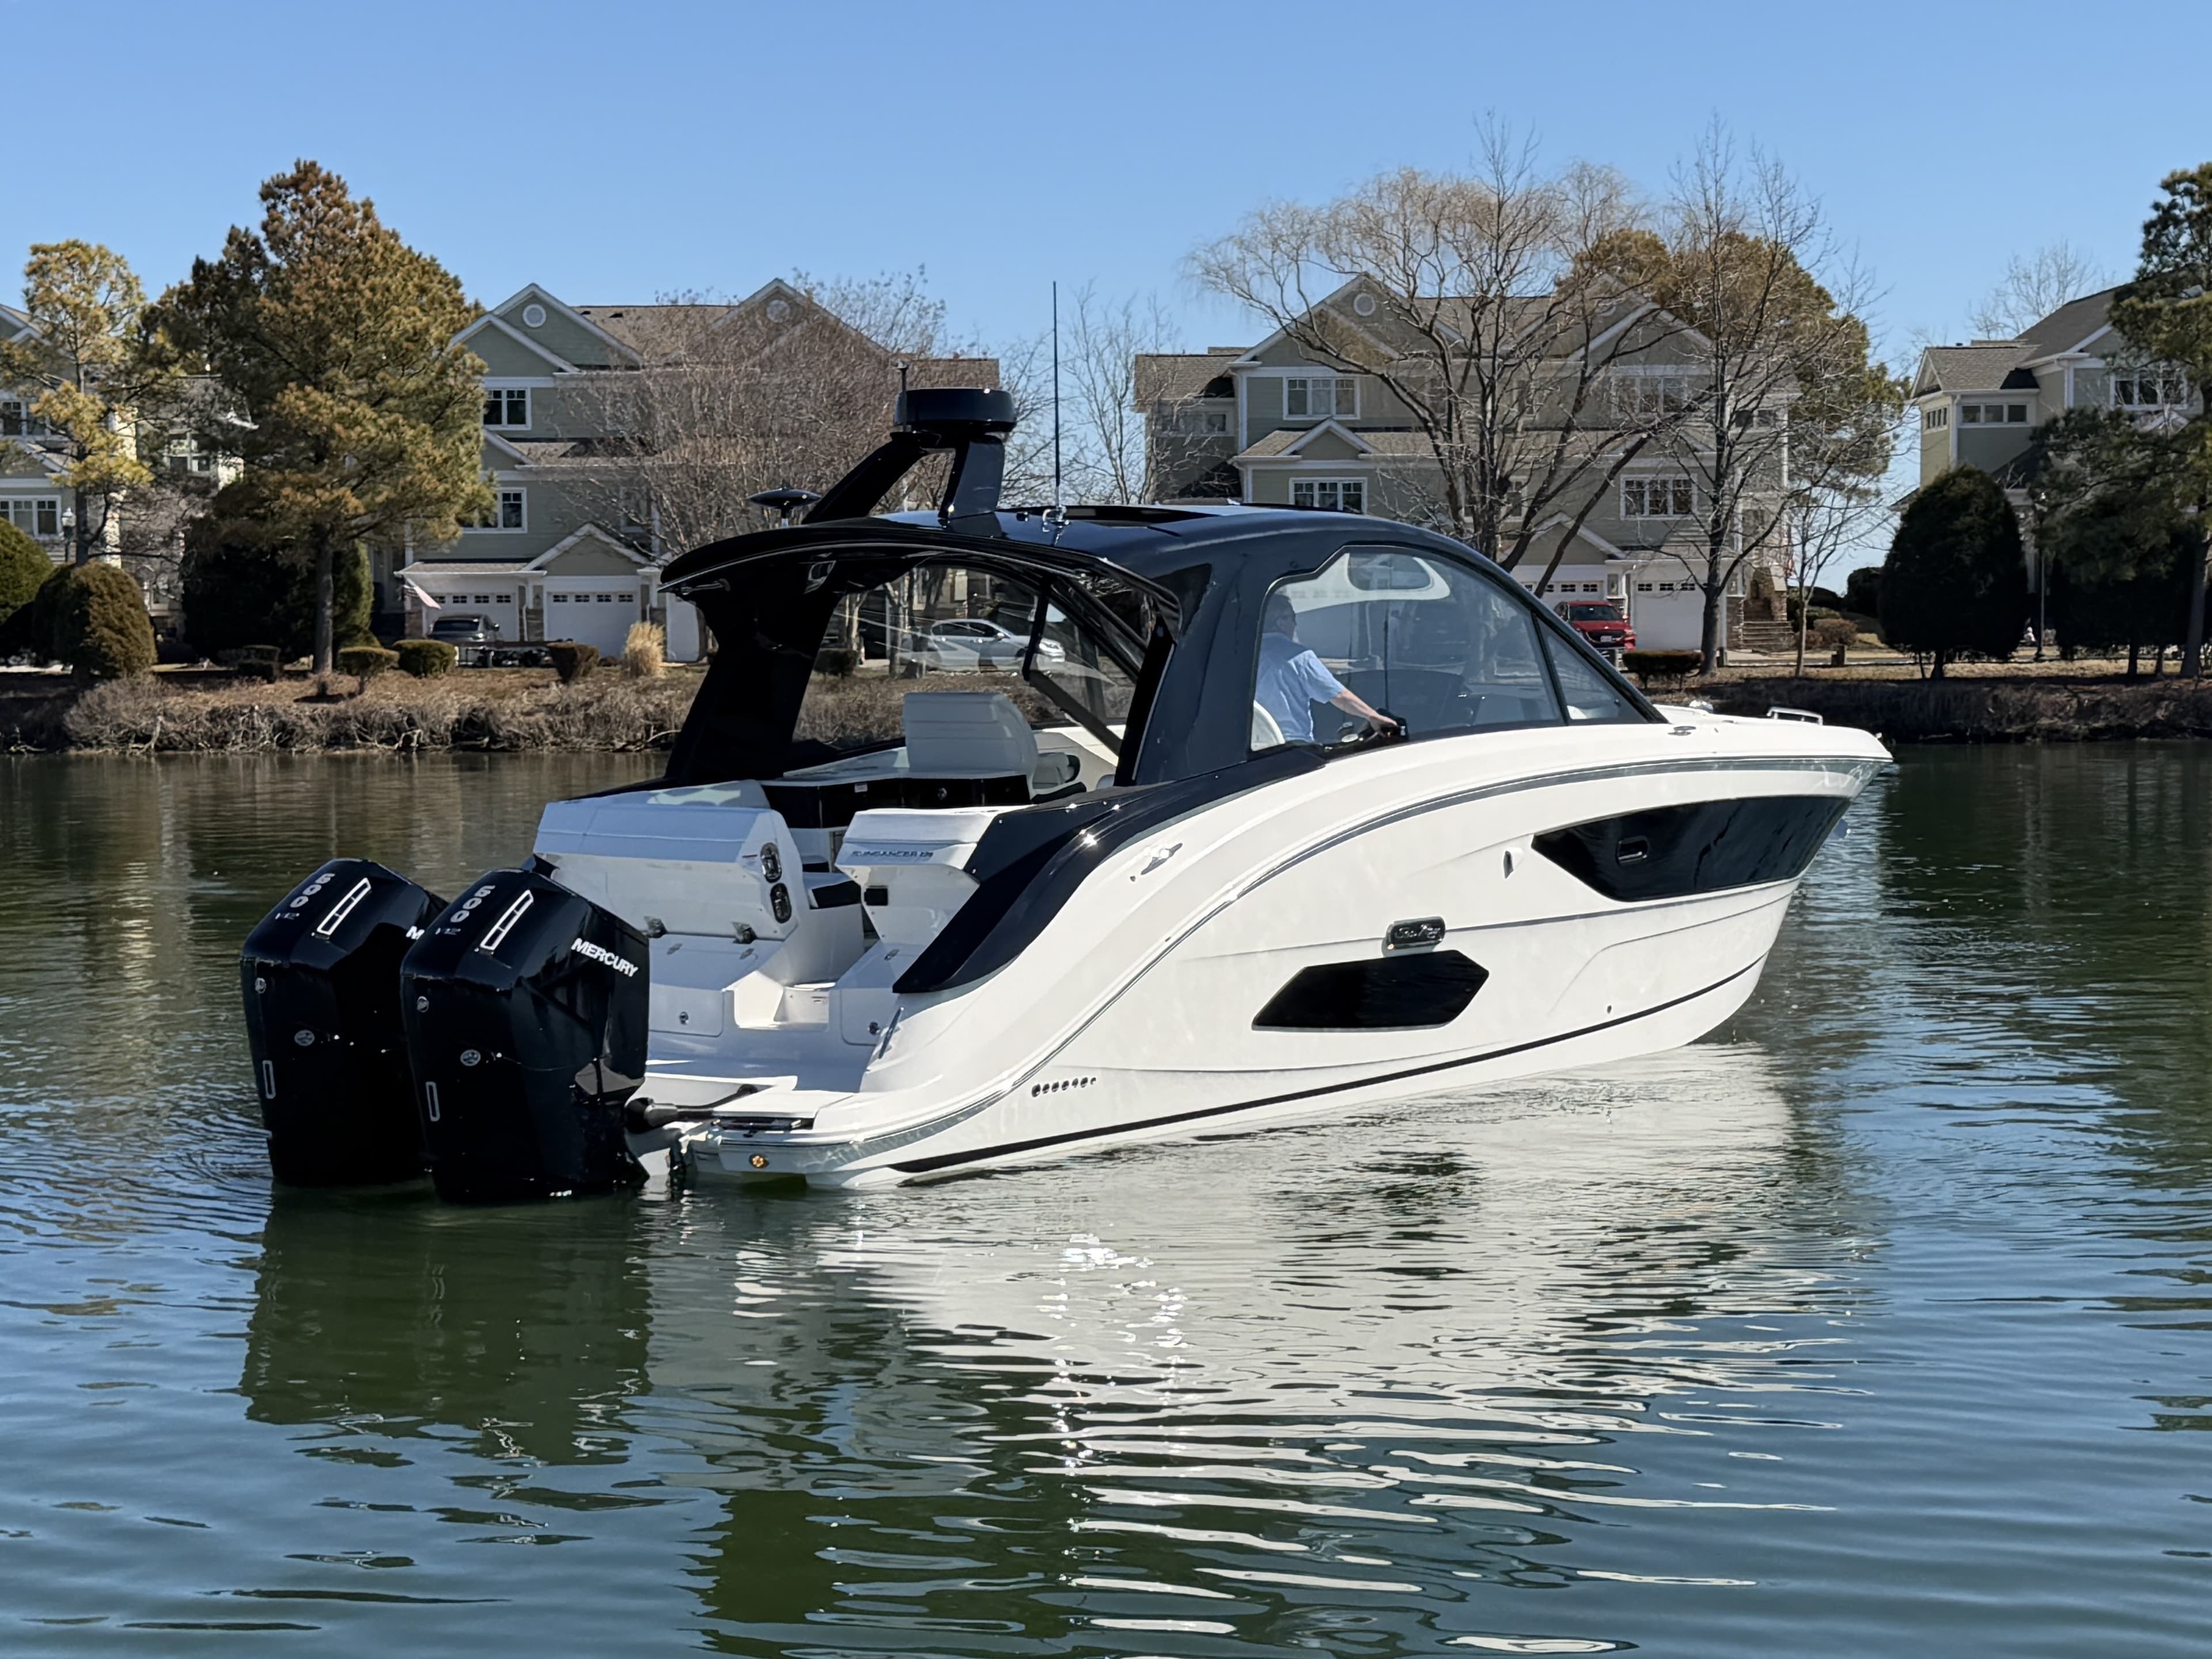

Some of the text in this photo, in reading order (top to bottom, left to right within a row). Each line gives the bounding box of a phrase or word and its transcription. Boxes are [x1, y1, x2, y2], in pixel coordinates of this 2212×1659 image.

[290, 873, 335, 908] 600
[450, 885, 496, 923] 600
[571, 938, 639, 977] MERCURY
